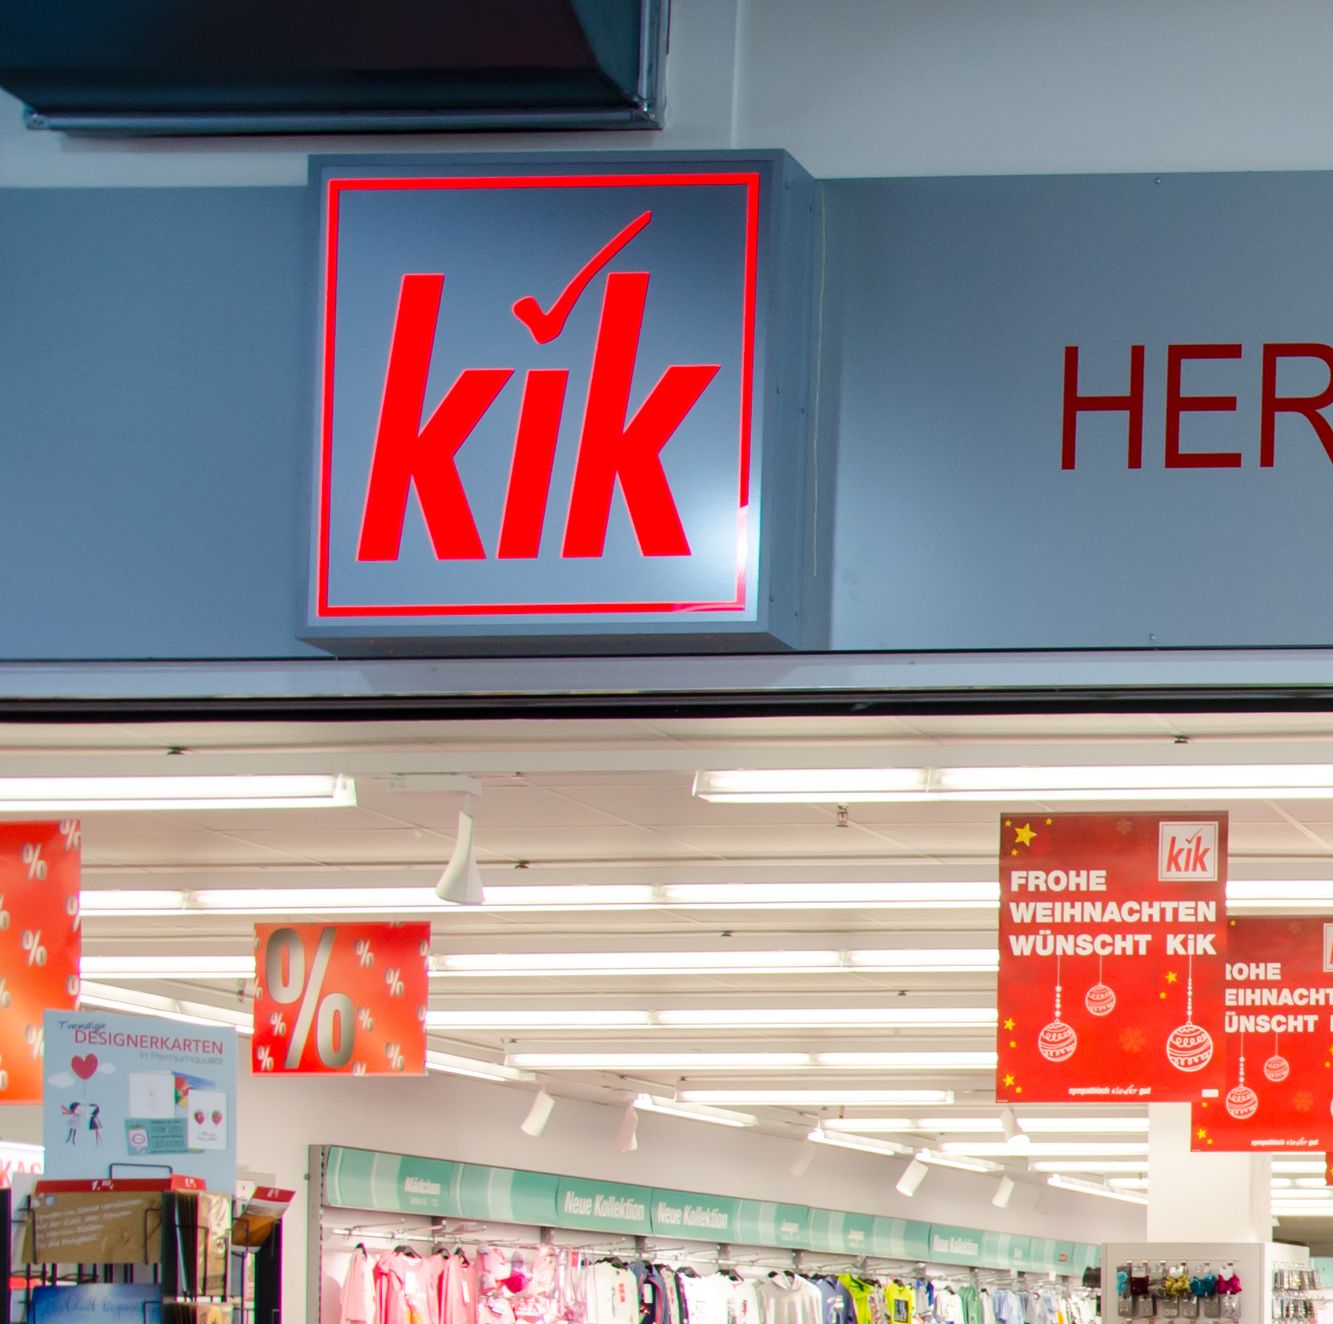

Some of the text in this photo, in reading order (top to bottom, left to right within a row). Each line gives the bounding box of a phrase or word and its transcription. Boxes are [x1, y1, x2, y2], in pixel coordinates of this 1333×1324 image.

[356, 210, 722, 562] kik
[1166, 828, 1211, 873] kik
[1010, 870, 1107, 892] FROHE
[1009, 901, 1217, 924] WEIHNACHTEN
[1009, 929, 1217, 956] WÜNSCHT KiK
[74, 1030, 224, 1055] DESIGNERKARTEN
[564, 1190, 645, 1222] Neue Kollektion
[657, 1201, 728, 1230] Neue Kollektion
